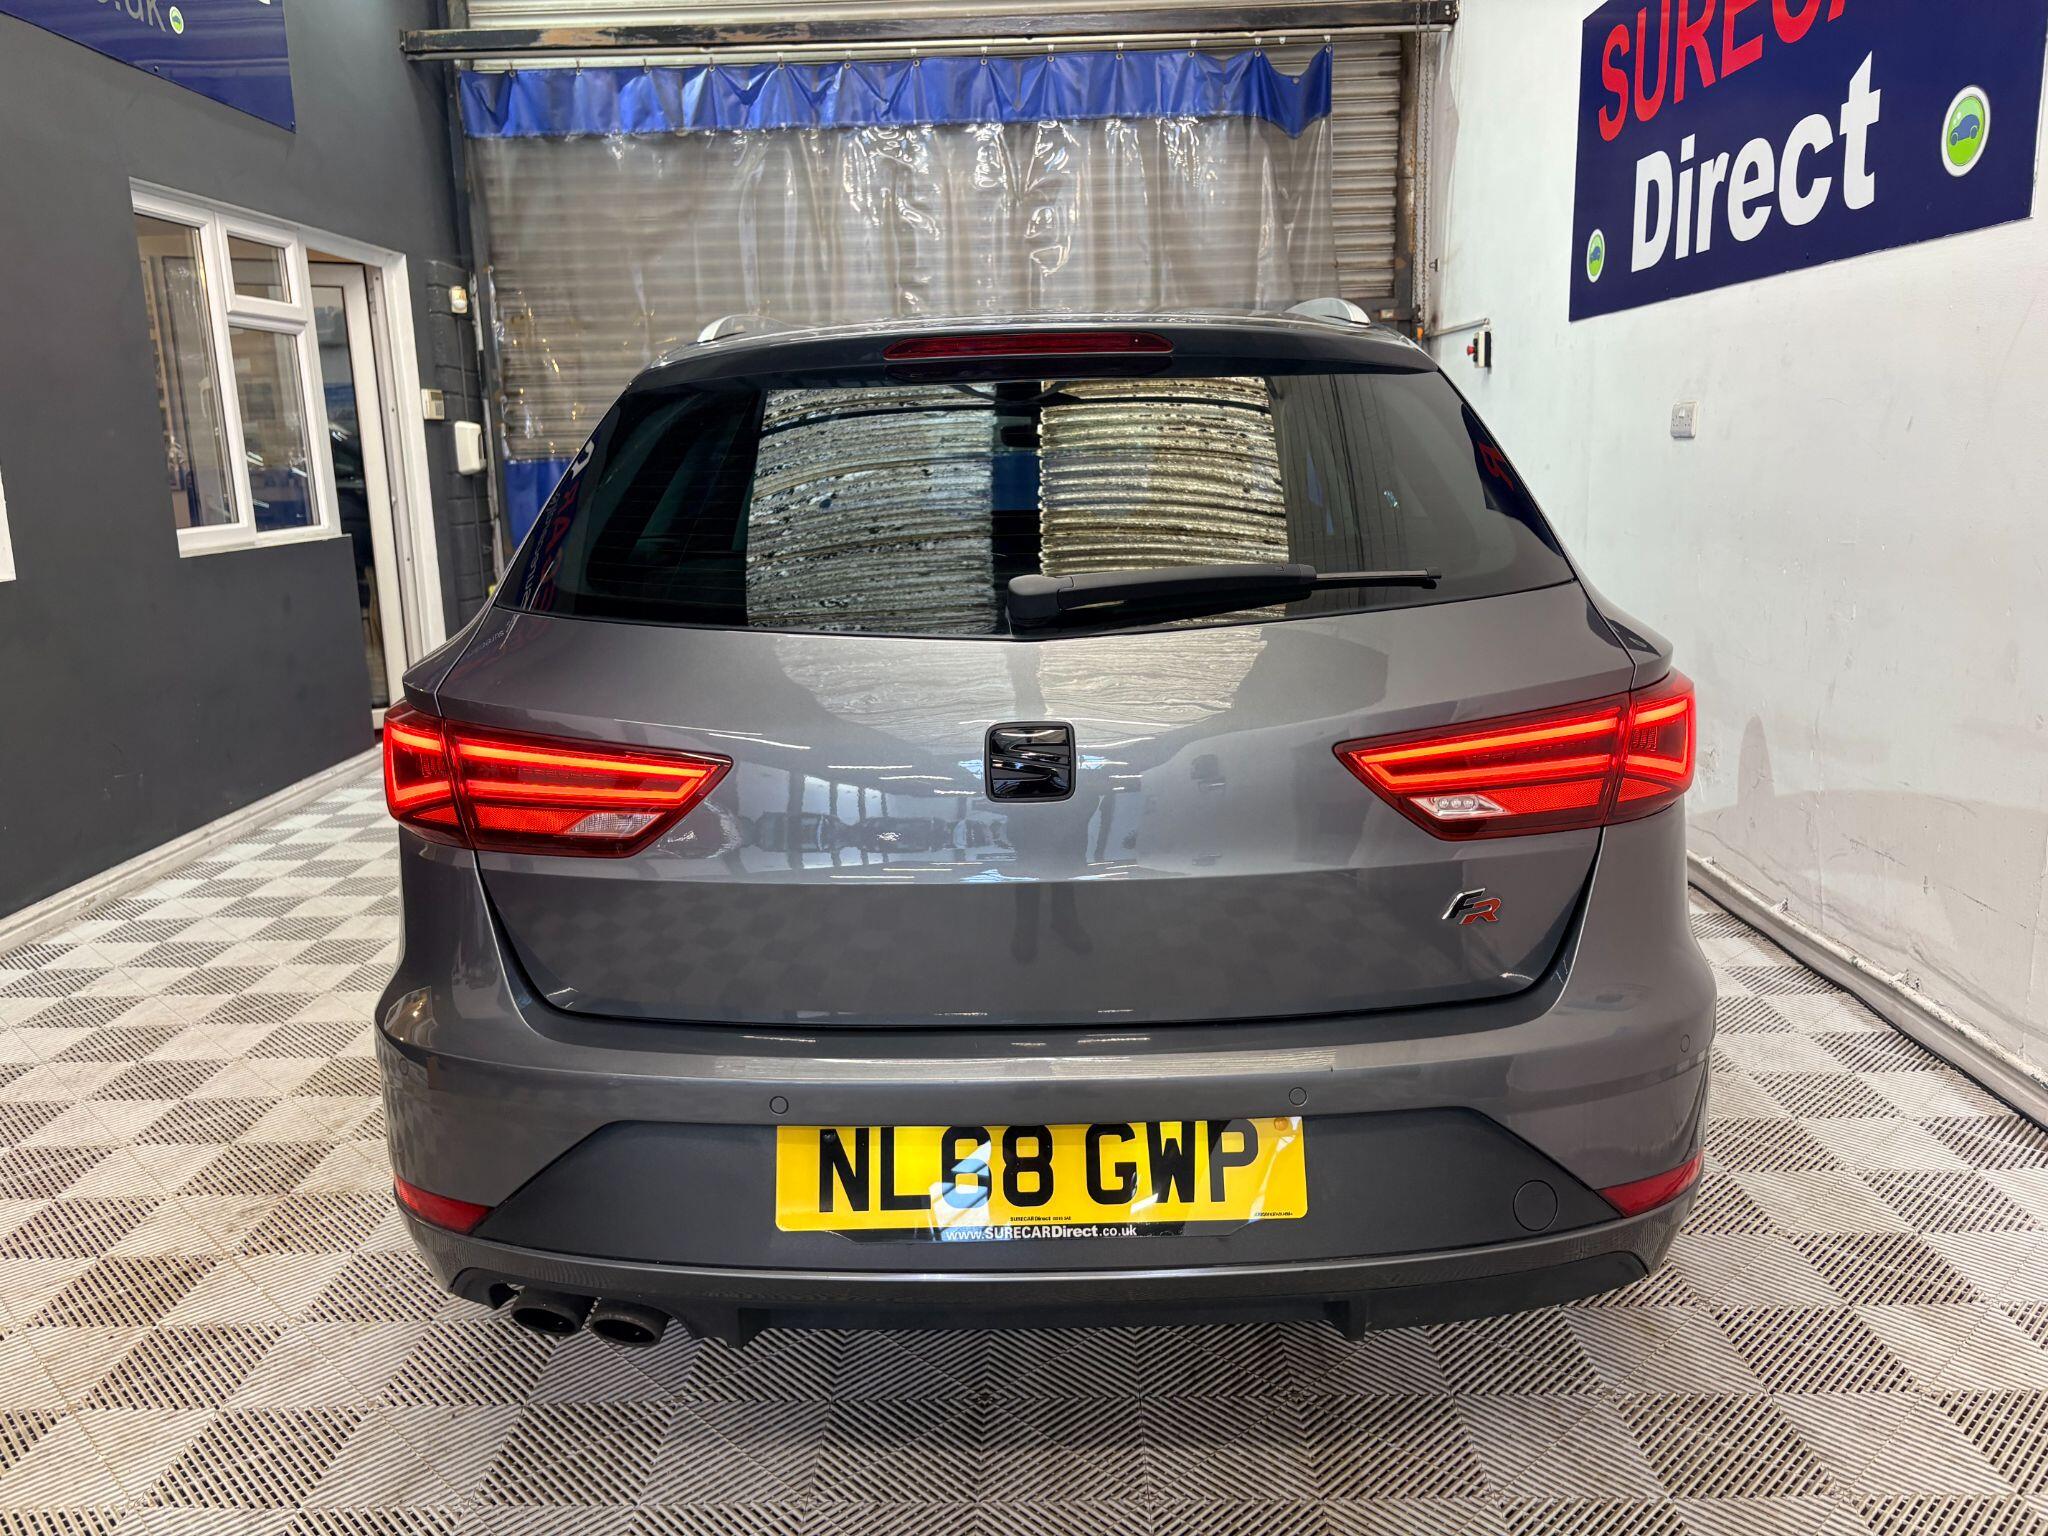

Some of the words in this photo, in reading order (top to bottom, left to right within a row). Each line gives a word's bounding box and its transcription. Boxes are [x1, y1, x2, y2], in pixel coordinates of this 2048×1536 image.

[1631, 50, 1881, 273] Direct
[1441, 887, 1502, 926] FR
[819, 1123, 1054, 1213] NL68
[1085, 1117, 1259, 1208] GWP
[946, 1224, 1138, 1241] www.SURECARDirect.co.uk
